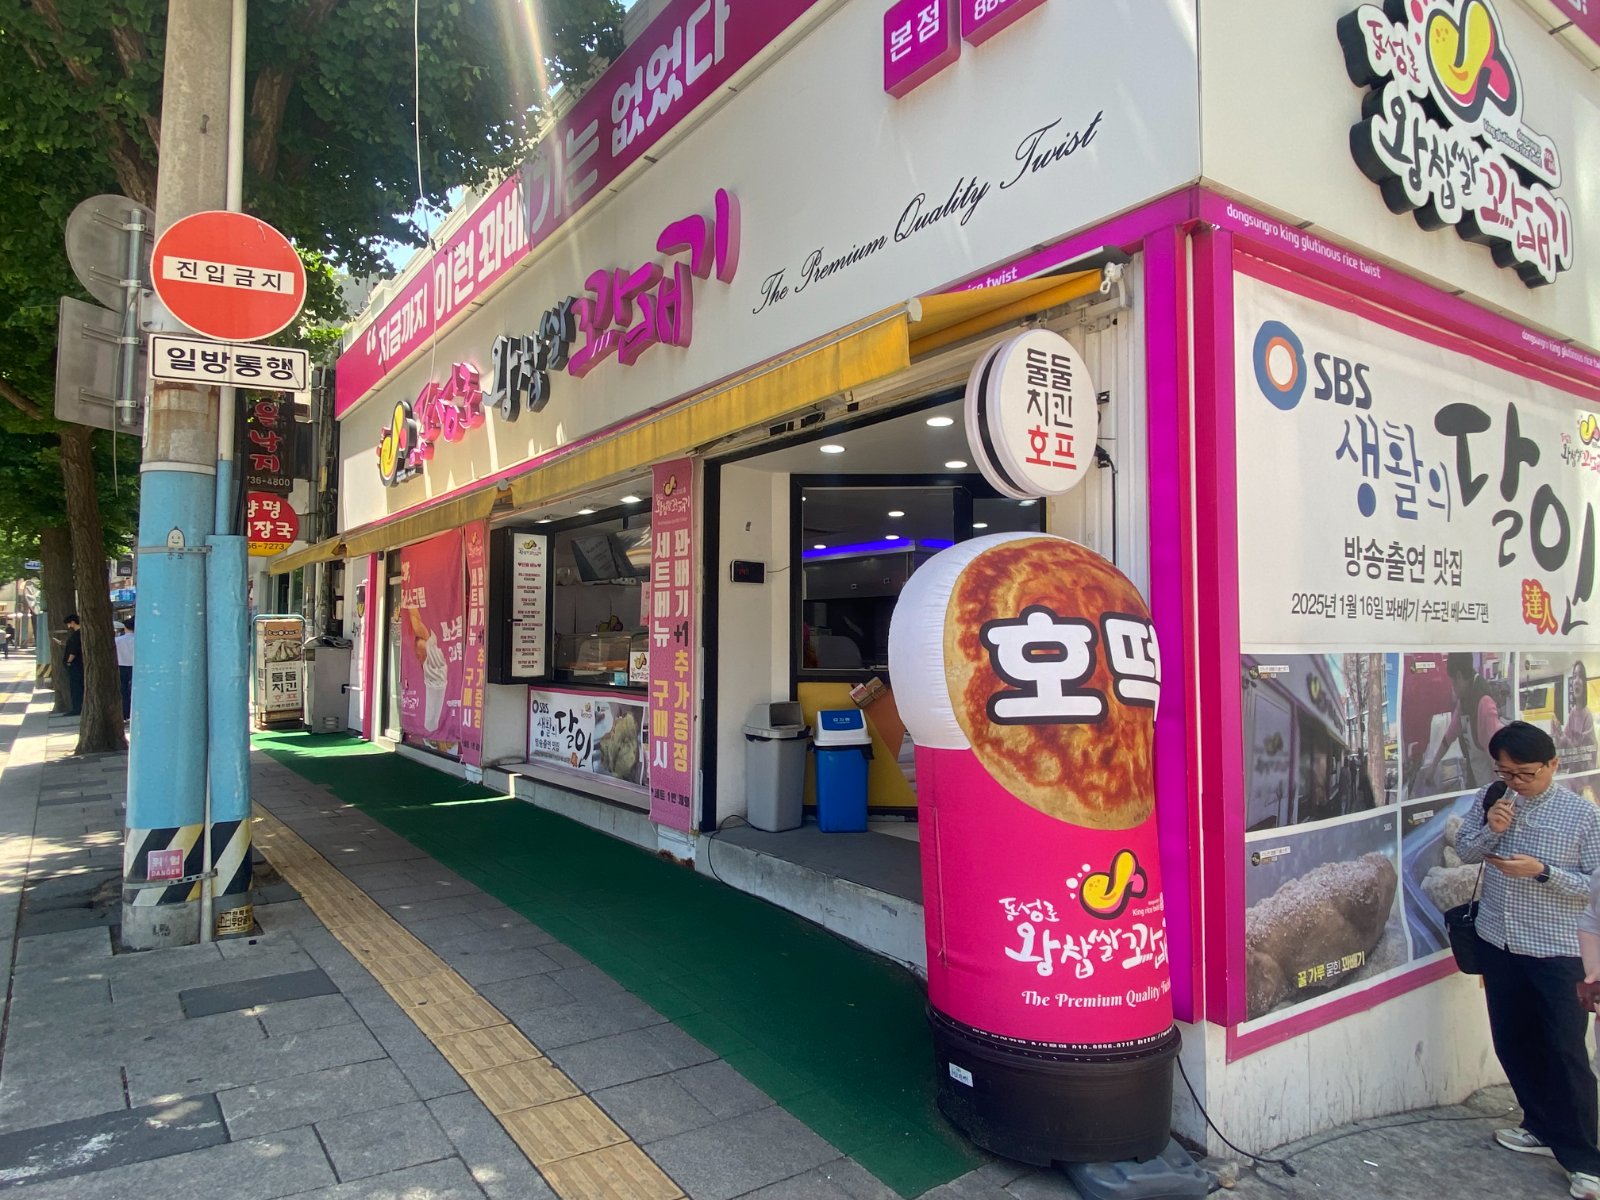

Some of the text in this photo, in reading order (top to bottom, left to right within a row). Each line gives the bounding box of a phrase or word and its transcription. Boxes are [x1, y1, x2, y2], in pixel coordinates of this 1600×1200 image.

[889, 0, 940, 62] 본점
[434, 230, 475, 321] 이런
[478, 118, 600, 283] 꽈배기는
[610, 0, 731, 158] 없었다
[752, 111, 1103, 314] The Premium Quality Twist
[1226, 203, 1381, 279] dongsungro king glutinous rice twist
[176, 258, 283, 292] 진입금지
[986, 266, 1019, 288] twist
[166, 345, 296, 381] 일방통행
[1026, 348, 1073, 392] 둘둘
[1314, 352, 1373, 410] SBS
[1026, 388, 1073, 429] 치킨
[1025, 424, 1077, 471] 호프
[247, 476, 290, 487] 36-4800
[248, 500, 281, 519] 양평
[1335, 401, 1597, 636] 생활의 달인
[248, 520, 294, 539] 장국
[1344, 536, 1464, 587] 방송출연 맛집
[1291, 593, 1337, 618] 2025년
[1339, 594, 1357, 619] 1월
[1359, 596, 1385, 620] 16일
[1385, 597, 1420, 622] 꽈배기
[1421, 600, 1449, 622] 수도권
[652, 531, 671, 769] 세트메뉴 구매시
[673, 528, 691, 773] 꽈배기 +1 추가증정
[272, 681, 297, 693] 치킨
[151, 868, 181, 877] DANGER
[998, 897, 1061, 922] 동성로
[1341, 950, 1365, 972] 꽈배기
[1021, 986, 1161, 1008] The Premium Quality
